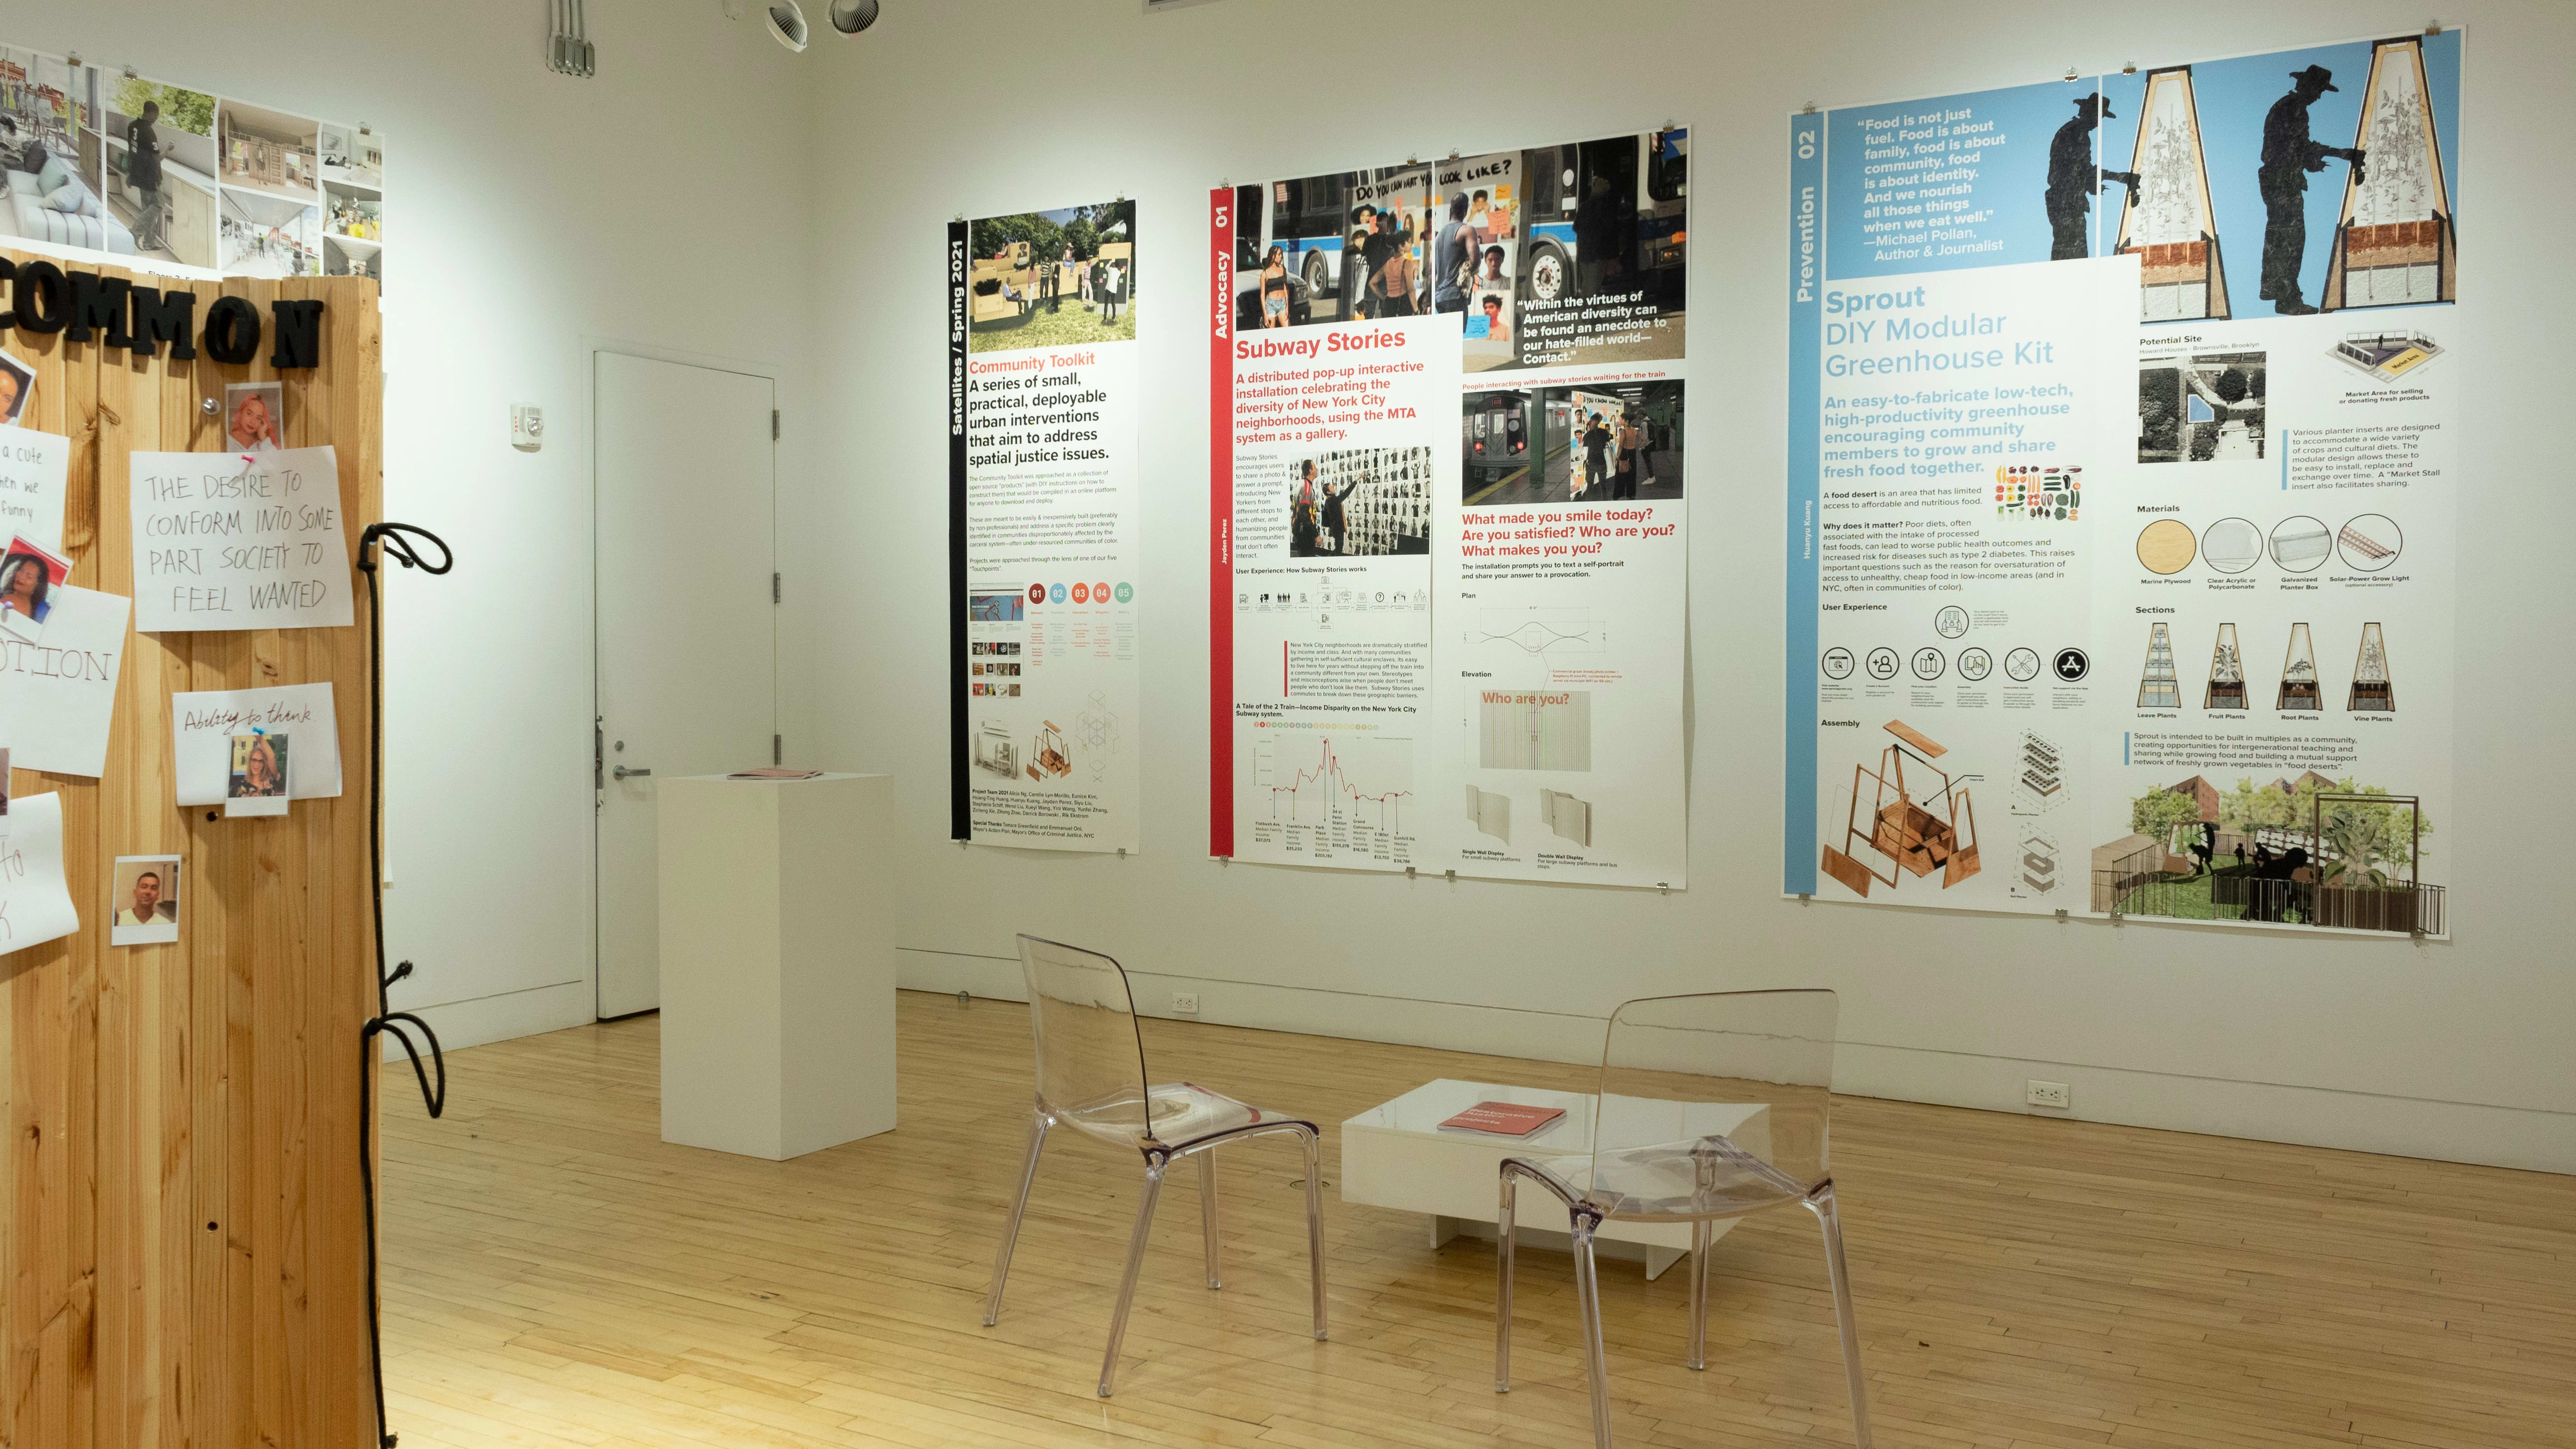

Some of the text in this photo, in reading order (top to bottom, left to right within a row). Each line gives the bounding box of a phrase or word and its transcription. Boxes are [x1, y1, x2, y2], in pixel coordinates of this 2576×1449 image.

[1797, 131, 1815, 302] Prevention 02
[1863, 229, 1976, 246] —Michael Pollan,
[1874, 240, 2003, 261] Author & Journalist
[952, 241, 963, 283] 2021
[1215, 205, 1231, 339] Advocacy 01
[1517, 290, 1643, 311] “Within the virtues of
[1826, 286, 1925, 318] Sprout
[0, 256, 324, 368] OMMON
[952, 288, 965, 342] Spring
[1523, 306, 1657, 324] American diversity can
[1524, 318, 1667, 337] be found an anecdote to
[1827, 313, 2006, 345] DIY Modular
[1236, 328, 1405, 359] Subway Stories
[1524, 332, 1652, 351] our hate-filled world—
[2140, 336, 2180, 345] Potential
[969, 351, 1094, 374] Community Toolkit
[1523, 350, 1576, 364] Contact.”
[1826, 341, 2053, 377] Greenhouse Kit
[969, 372, 1080, 392] A series of small,
[953, 359, 963, 435] Satellites
[970, 390, 1106, 413] practical, deployable
[1824, 383, 2073, 409] An easy-to-fabricate low-tech,
[970, 409, 1099, 429] urban interventions
[1825, 403, 2070, 428] high-productivity greenhouse
[969, 429, 1097, 447] that aim to address
[1824, 422, 2024, 443] encouraging community
[3, 446, 42, 464] a cute
[969, 447, 1109, 468] spatial justice issues.
[1825, 440, 2055, 461] members to grow and share
[1824, 461, 1984, 478] fresh food together.
[25, 483, 38, 493] we
[145, 470, 301, 501] THE DESIRE TO
[1, 500, 33, 522] funny
[146, 505, 334, 537] CONFORM INTO SOME
[1462, 508, 1653, 525] What made you smile today?
[1462, 524, 1675, 543] Are you satisfied? Who are you?
[1804, 500, 1813, 559] Huanyu Kuang
[150, 543, 323, 575] PART SOCIETY TO
[1462, 542, 1602, 557] What makes you you?
[172, 581, 326, 612] FEEL WANTED
[1032, 588, 1129, 598] 01 02 03 04 05
[246, 709, 261, 724] to
[1821, 720, 1859, 728] Assembly
